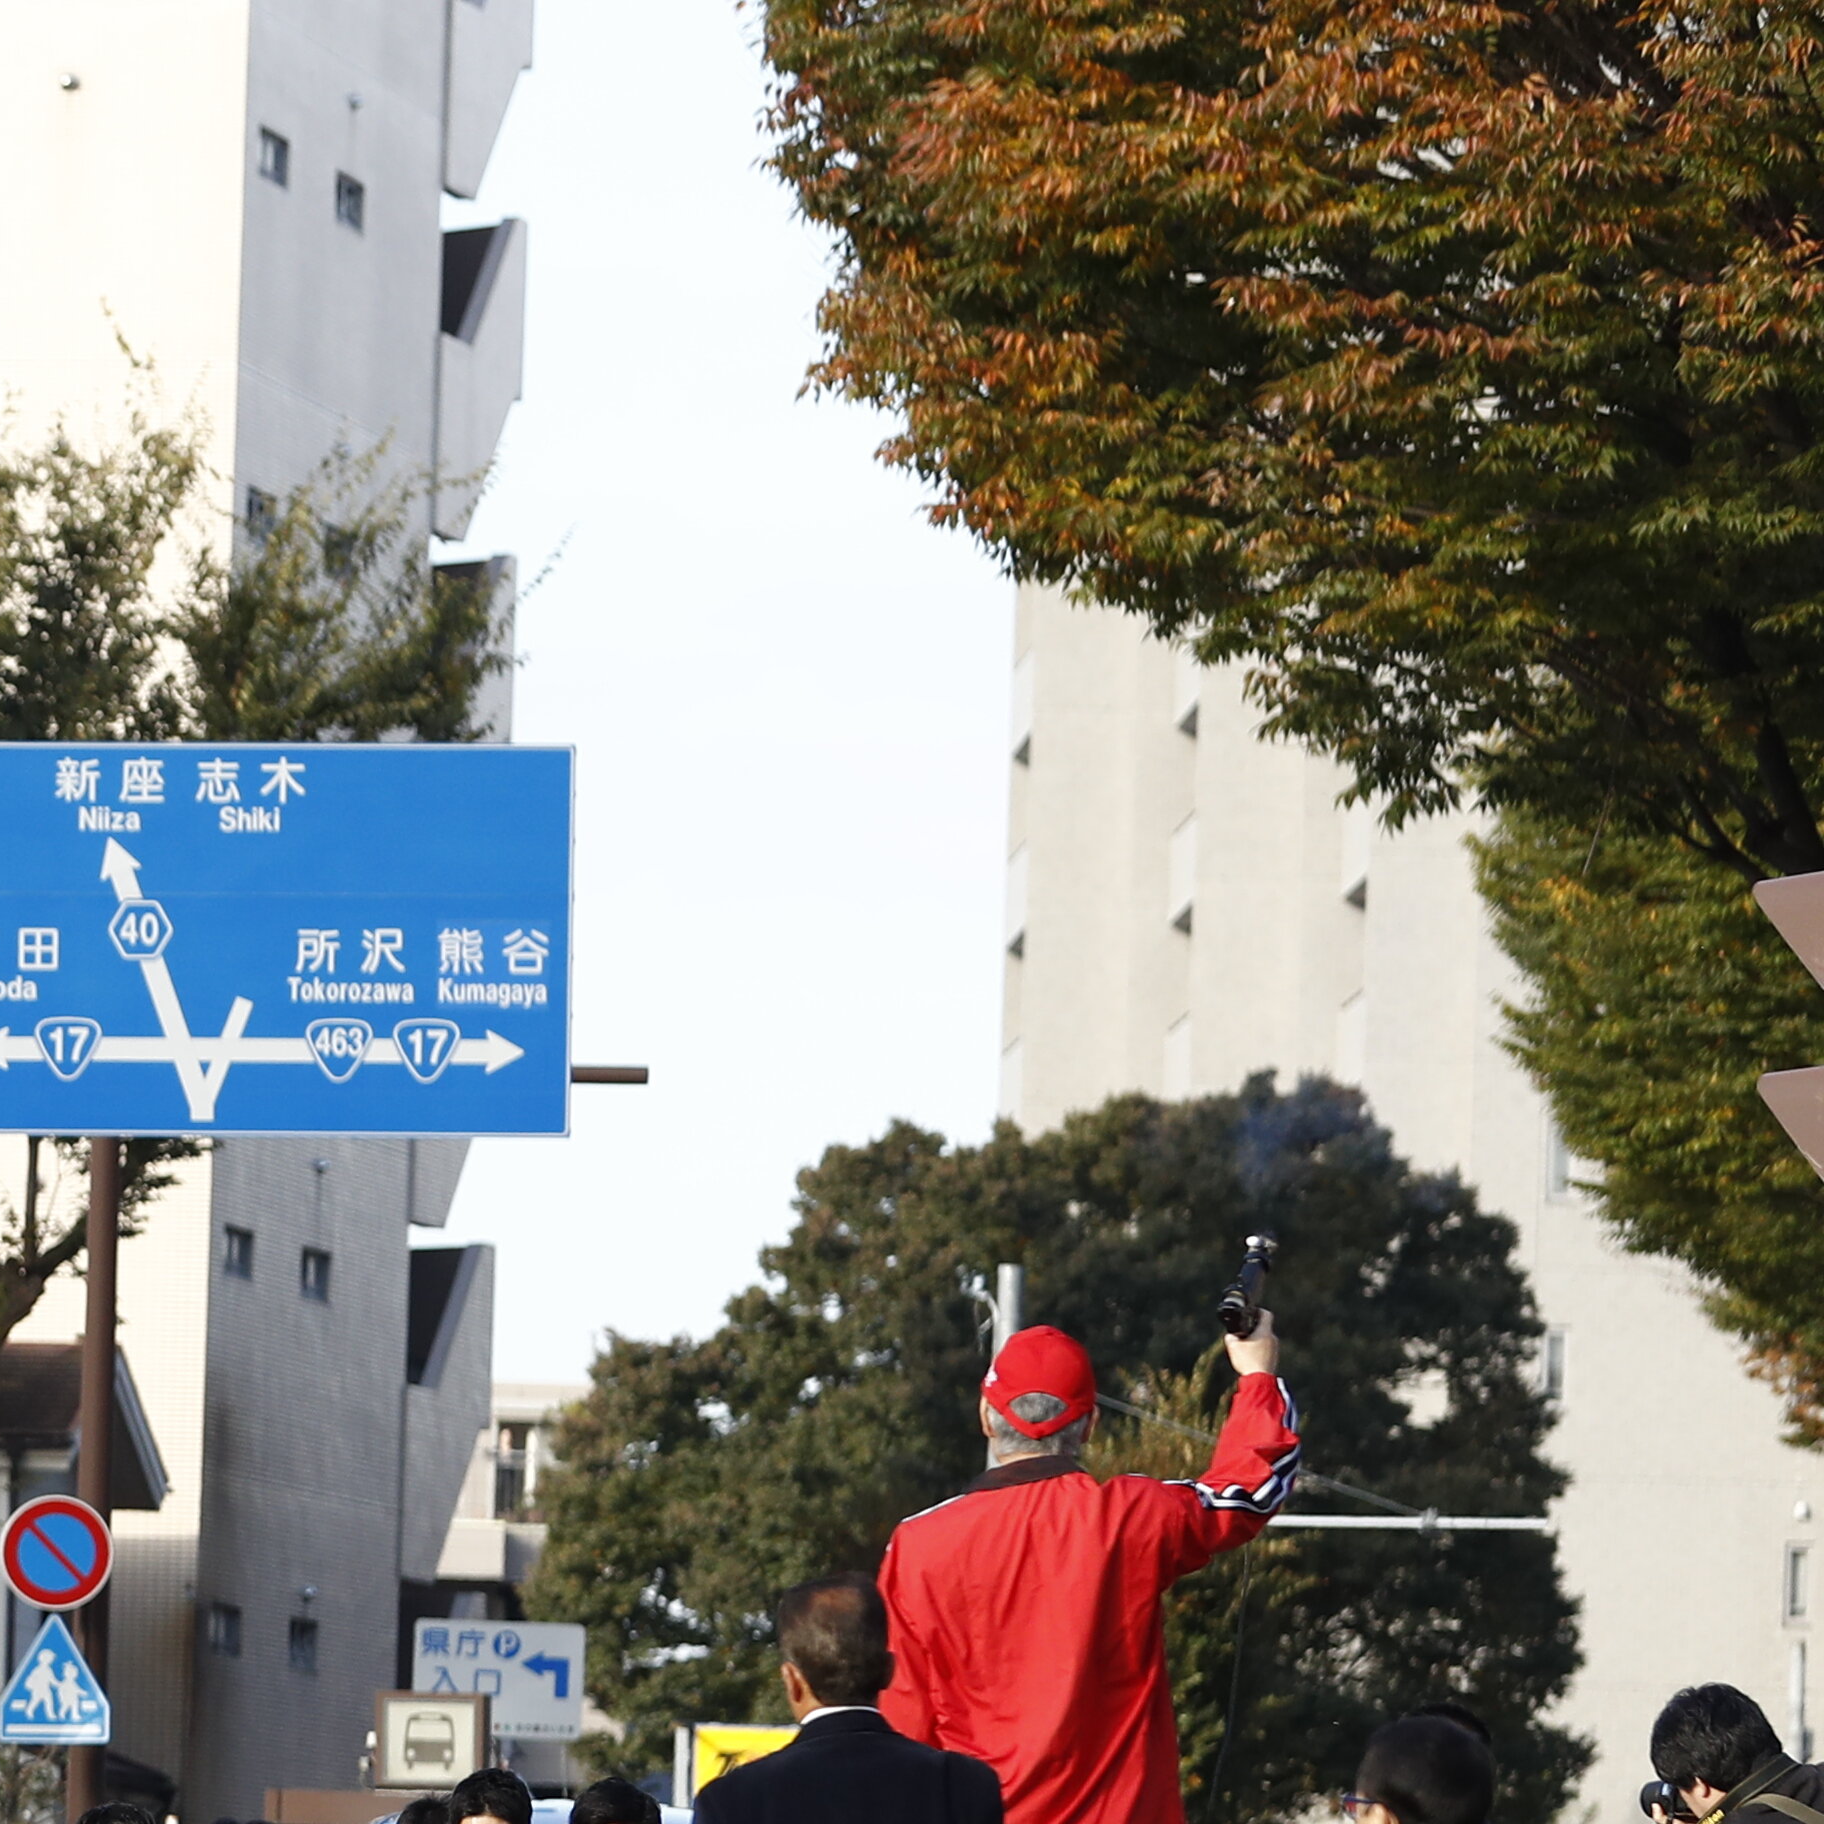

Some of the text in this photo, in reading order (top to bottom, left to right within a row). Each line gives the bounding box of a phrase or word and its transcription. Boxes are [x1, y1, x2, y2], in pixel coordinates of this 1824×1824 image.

[55, 757, 306, 803] 新座 志木
[78, 806, 281, 832] Niiza Shiki
[119, 917, 155, 944] 40
[296, 928, 549, 974] 所沢 熊谷
[287, 977, 548, 1008] Tokorozawa Kumagaya
[48, 1026, 87, 1062] 17
[315, 1027, 364, 1056] 463
[407, 1029, 447, 1064] 17
[422, 1627, 485, 1657] 県庁
[432, 1666, 501, 1696] 入口
